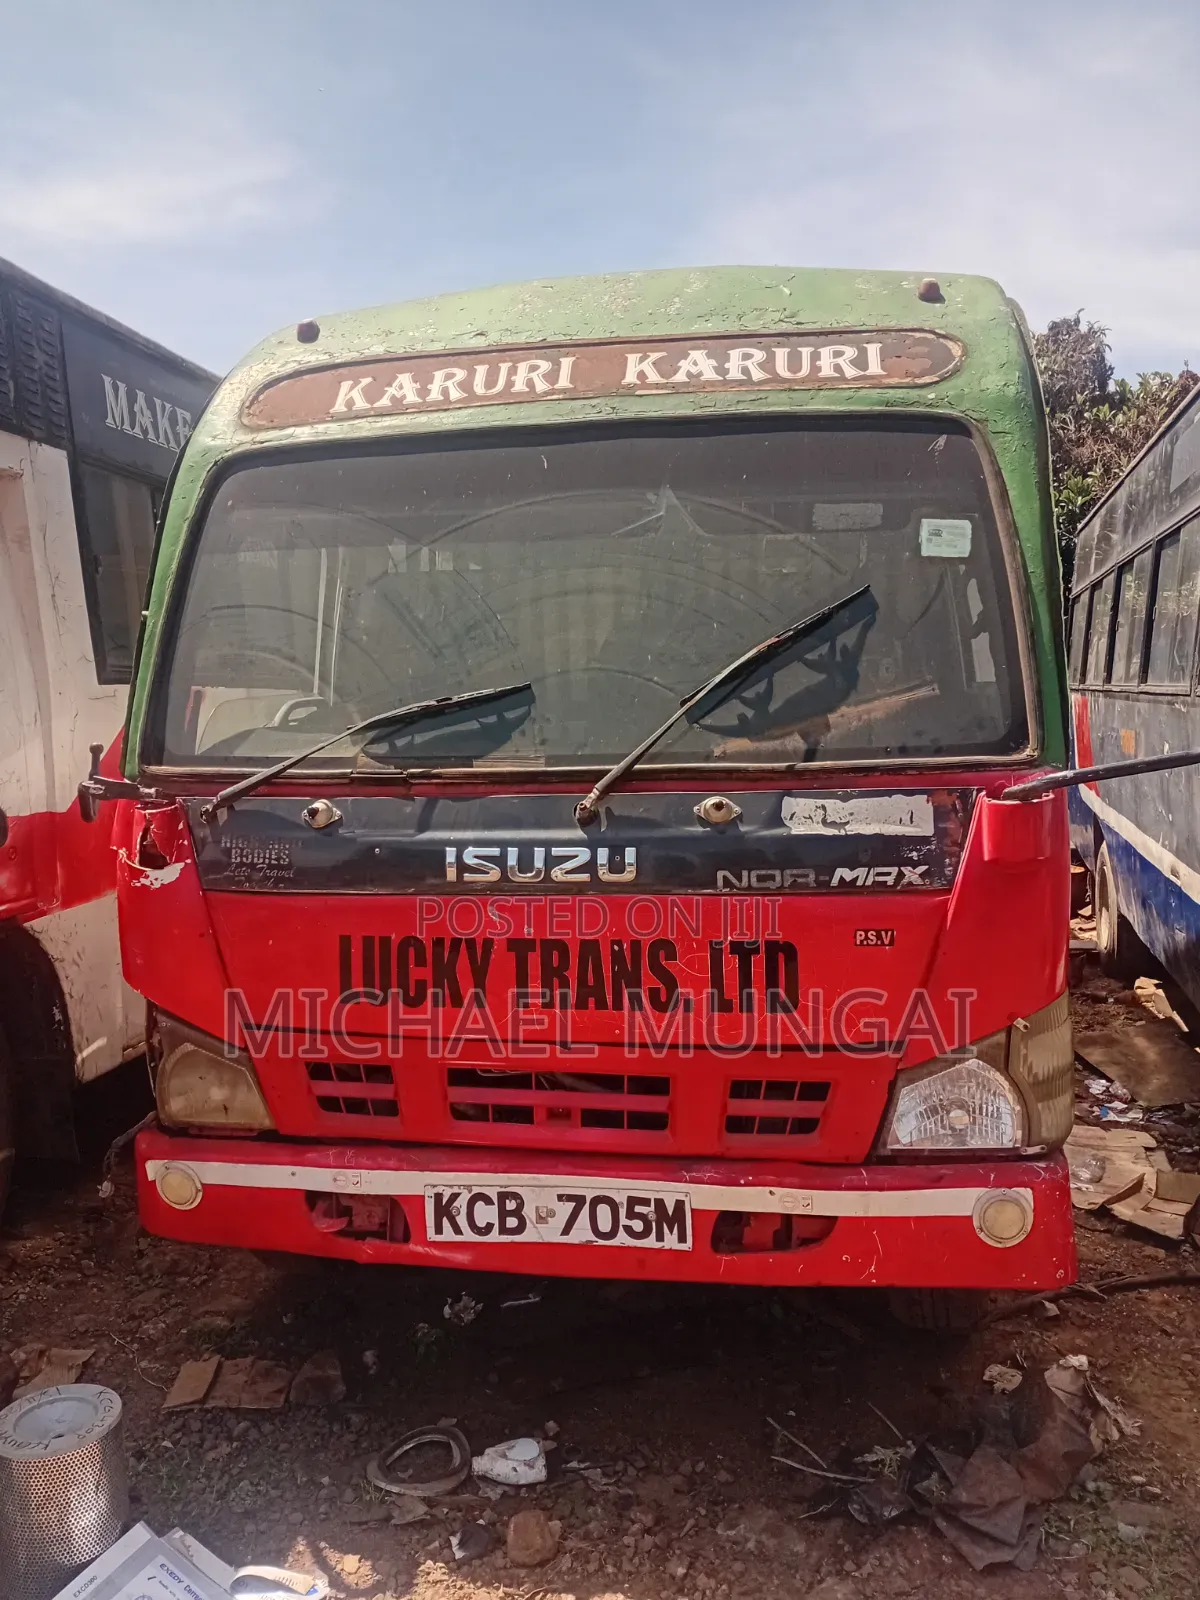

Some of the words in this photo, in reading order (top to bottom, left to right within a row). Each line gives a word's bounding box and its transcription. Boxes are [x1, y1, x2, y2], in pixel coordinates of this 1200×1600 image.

[330, 356, 580, 413] KARURI
[621, 343, 888, 385] KARURI
[231, 848, 290, 865] BODIES
[256, 864, 297, 878] Travel
[445, 847, 637, 883] ISUZU
[338, 934, 495, 1009] LUCKY
[708, 939, 799, 1014] LTD
[433, 1191, 527, 1238] KCB
[556, 1193, 688, 1245] 705M
[159, 1563, 184, 1584] EXEDY
